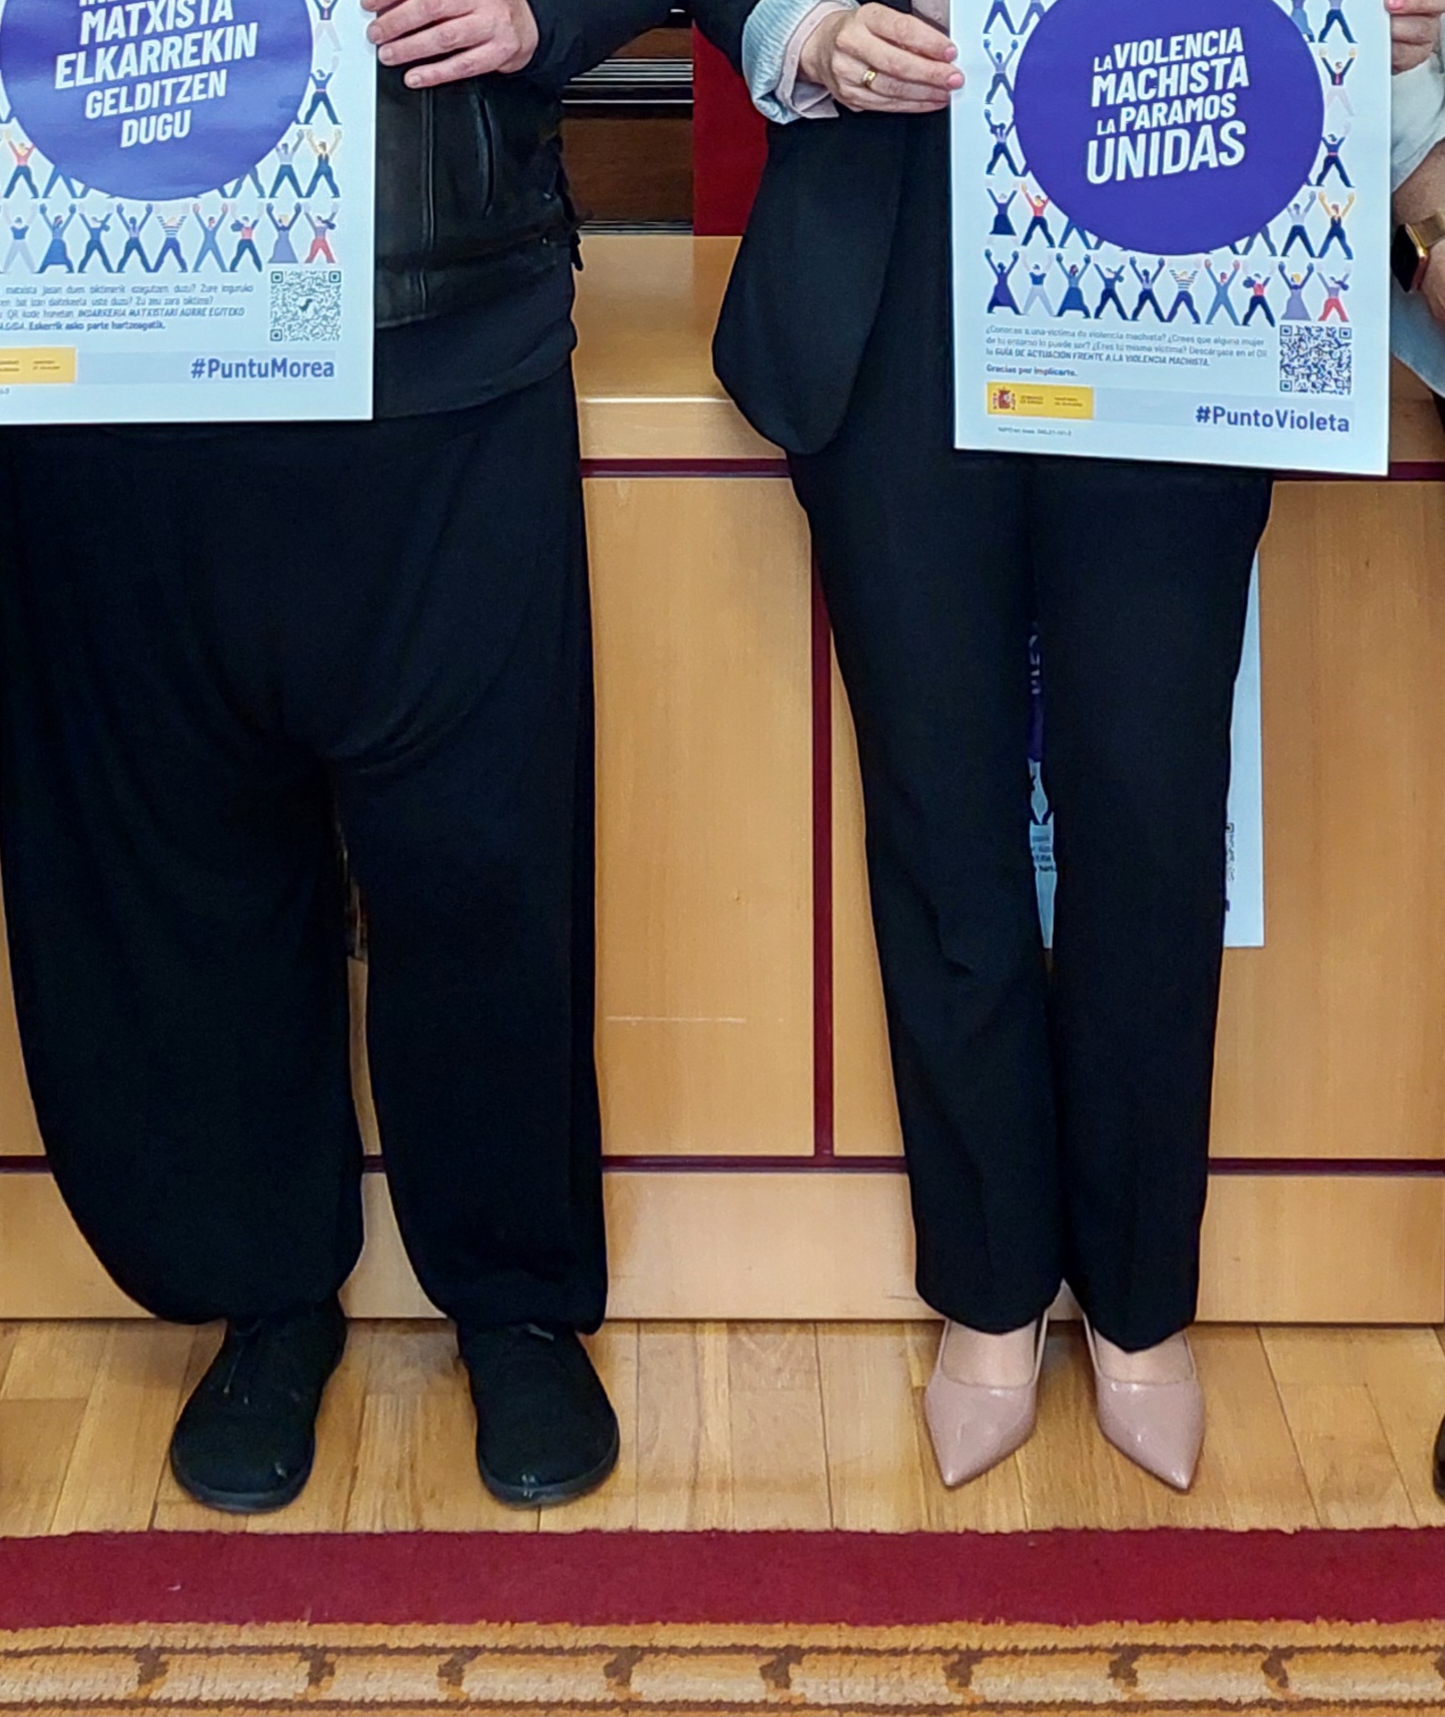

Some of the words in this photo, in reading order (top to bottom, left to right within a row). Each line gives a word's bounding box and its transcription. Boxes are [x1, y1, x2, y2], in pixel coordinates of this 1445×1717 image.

[55, 22, 258, 89] ELKARREKIN
[1093, 55, 1113, 72] LA
[1114, 27, 1244, 69] VIOLENCIA
[85, 69, 227, 119] GELDITZEN
[1091, 55, 1249, 107] MACHISTA
[120, 110, 192, 148] DUGU
[1097, 119, 1116, 135] LA
[1120, 93, 1237, 132] PARAMOS
[1087, 120, 1247, 184] UNIDAS
[191, 357, 335, 379] #PuntuMorea
[1195, 405, 1350, 432] #PuntoVioleta
